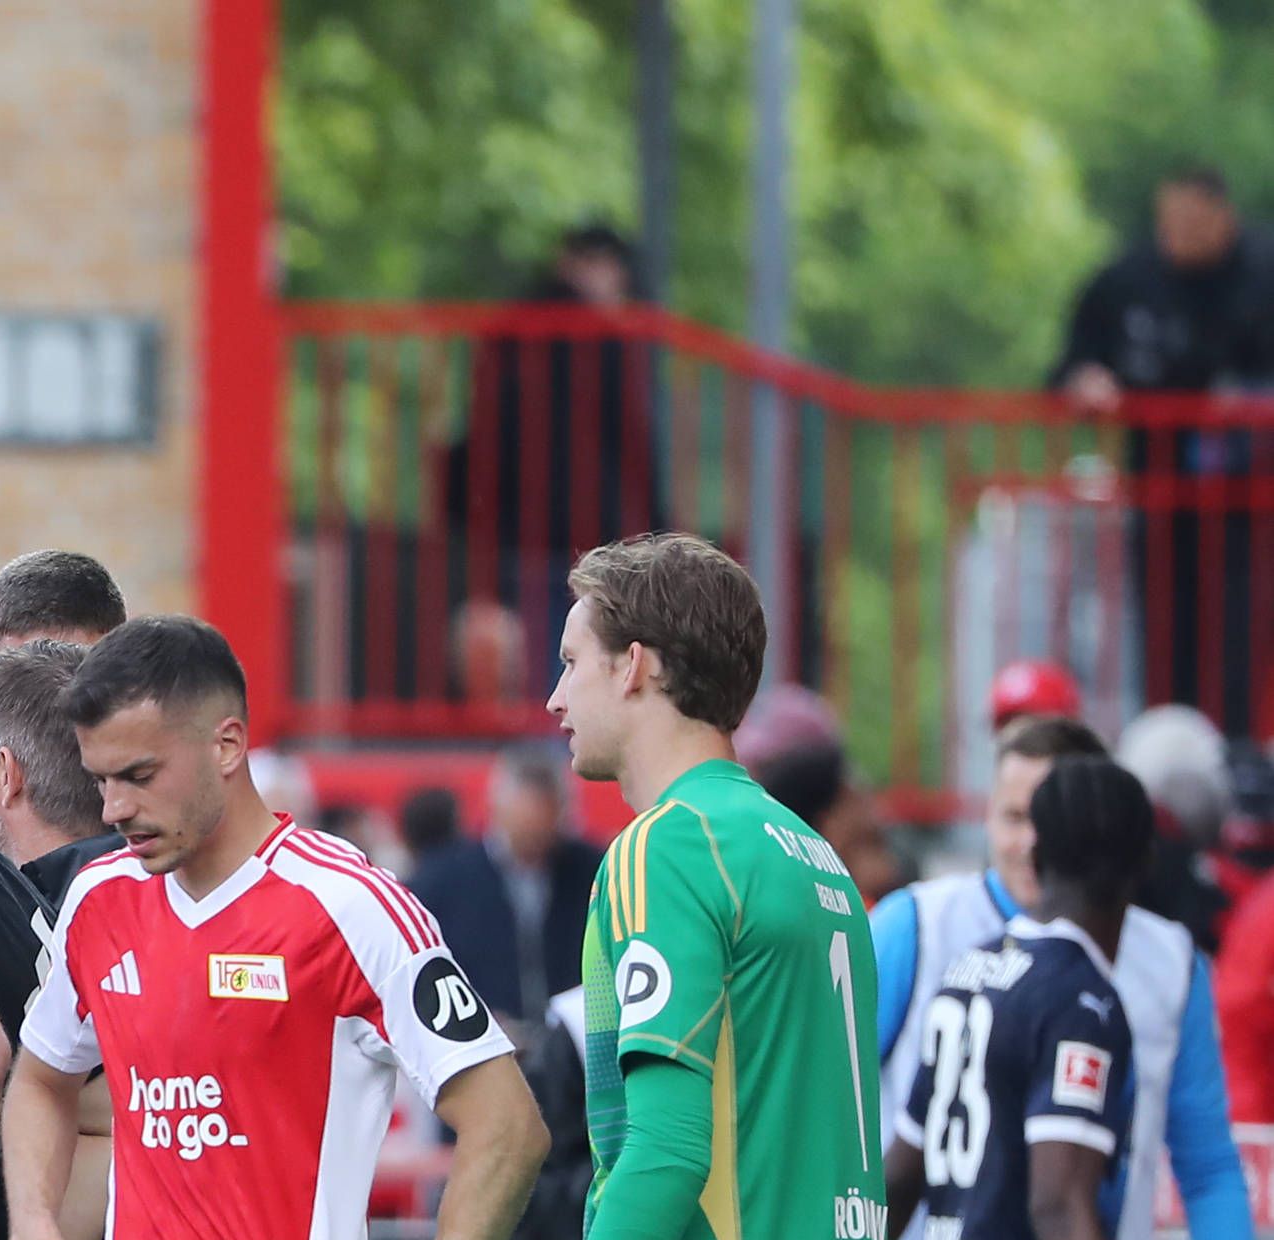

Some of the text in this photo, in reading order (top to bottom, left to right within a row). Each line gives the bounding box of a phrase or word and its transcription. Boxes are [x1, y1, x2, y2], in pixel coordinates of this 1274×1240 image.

[432, 976, 479, 1031] JD
[829, 930, 869, 1173] 1
[128, 1065, 223, 1112] home
[922, 993, 994, 1189] 23
[141, 1111, 172, 1148] to
